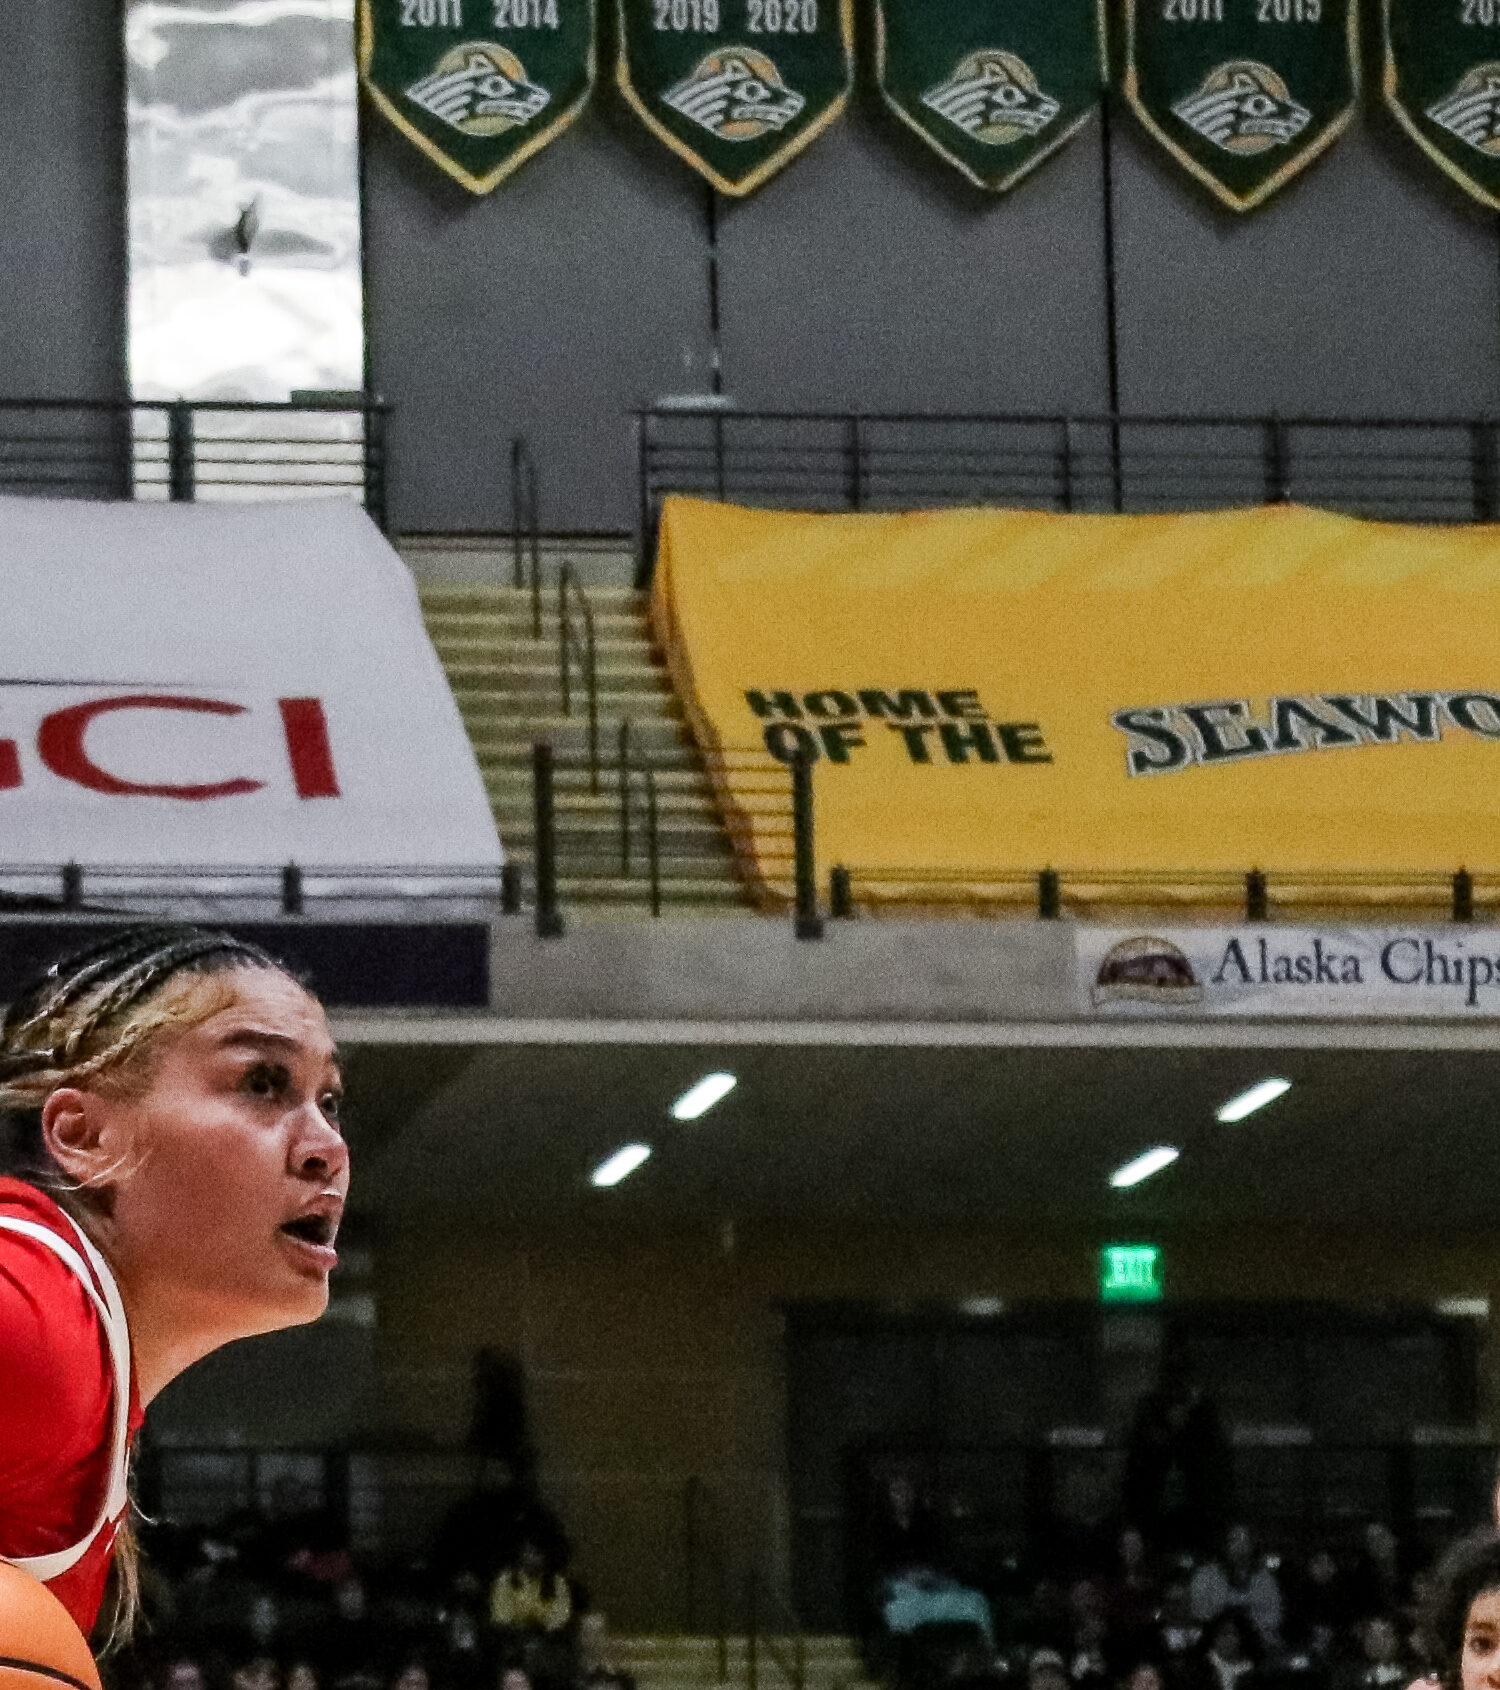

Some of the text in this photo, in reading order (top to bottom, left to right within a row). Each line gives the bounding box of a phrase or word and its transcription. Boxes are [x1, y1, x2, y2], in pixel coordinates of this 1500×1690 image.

[654, 0, 818, 34] 2019 2020
[745, 688, 988, 719] HOME
[762, 721, 1055, 766] OF THE
[1210, 937, 1365, 987] Alaska
